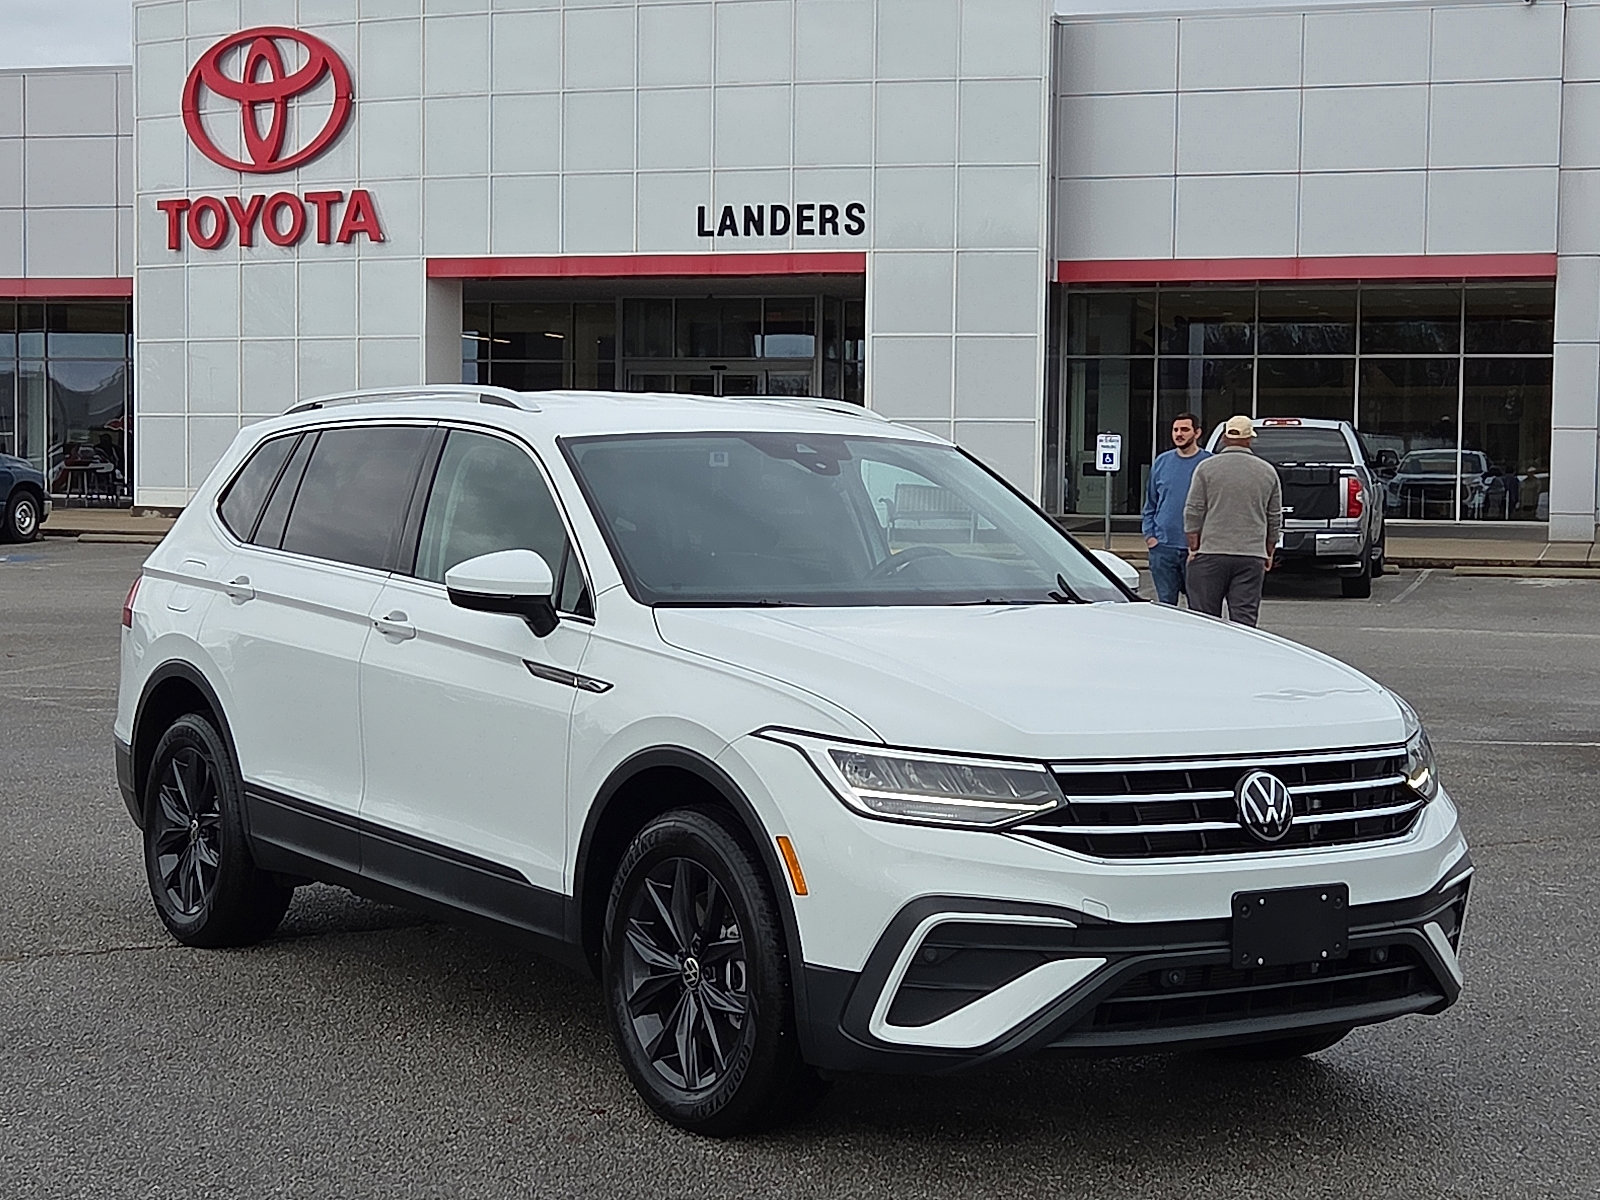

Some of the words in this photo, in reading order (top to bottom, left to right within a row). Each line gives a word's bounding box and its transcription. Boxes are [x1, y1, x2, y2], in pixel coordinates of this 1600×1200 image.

[157, 189, 385, 251] TOYOTA
[697, 202, 866, 237] LANDERS
[691, 1044, 752, 1118] GOODYEAR
